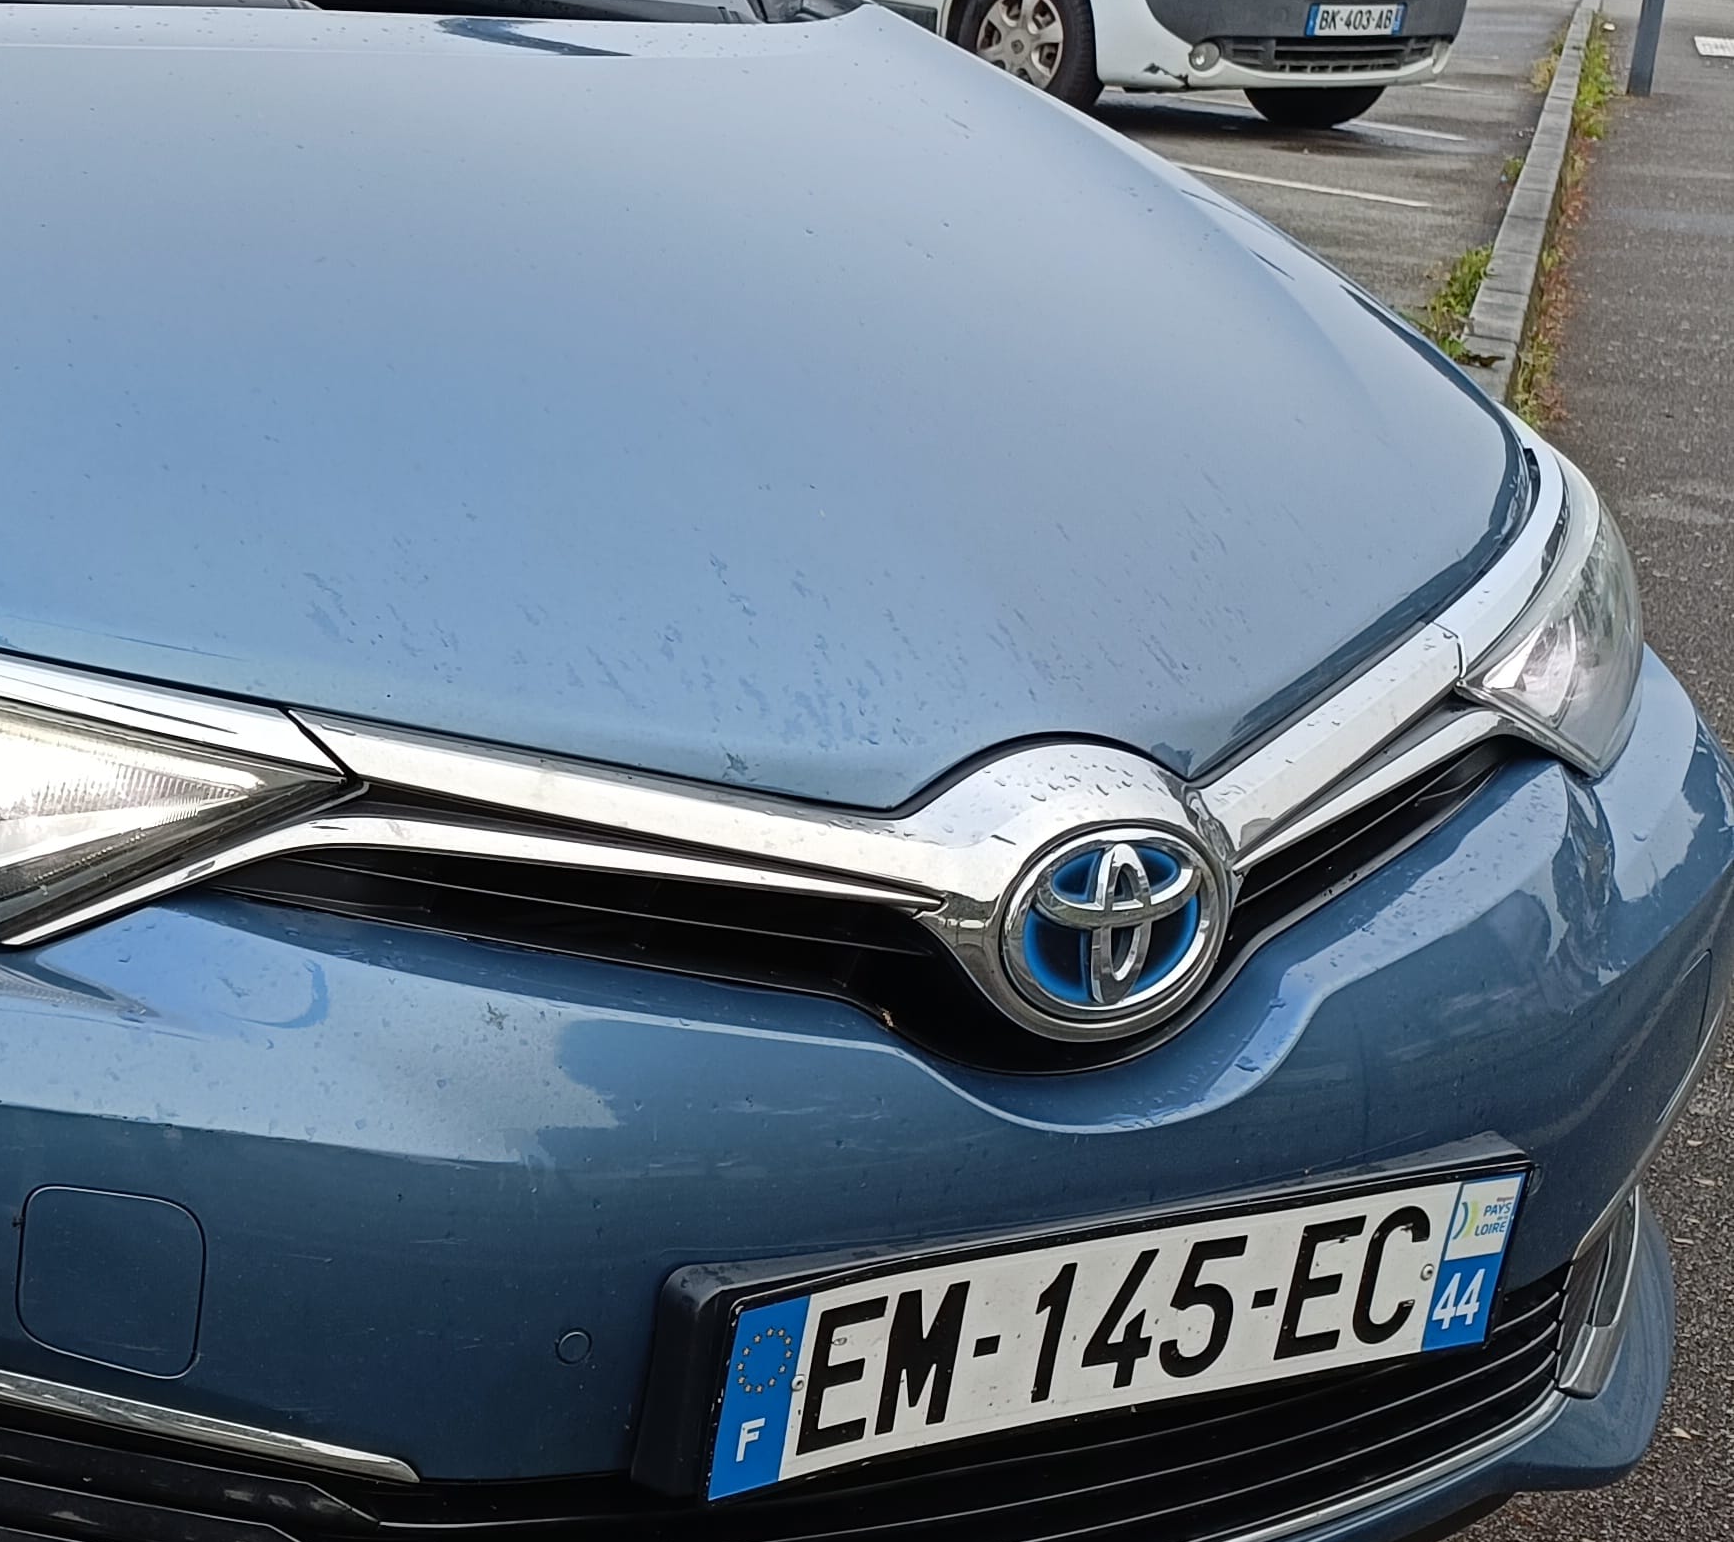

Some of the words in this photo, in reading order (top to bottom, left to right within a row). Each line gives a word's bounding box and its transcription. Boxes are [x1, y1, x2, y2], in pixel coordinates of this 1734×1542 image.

[1319, 9, 1393, 31] BK-403-AB
[1483, 1202, 1513, 1217] PAYS
[1474, 1222, 1507, 1237] LOIRE
[1432, 1268, 1486, 1330] 44
[796, 1205, 1432, 1457] EM-145-EC
[736, 1417, 766, 1464] F
